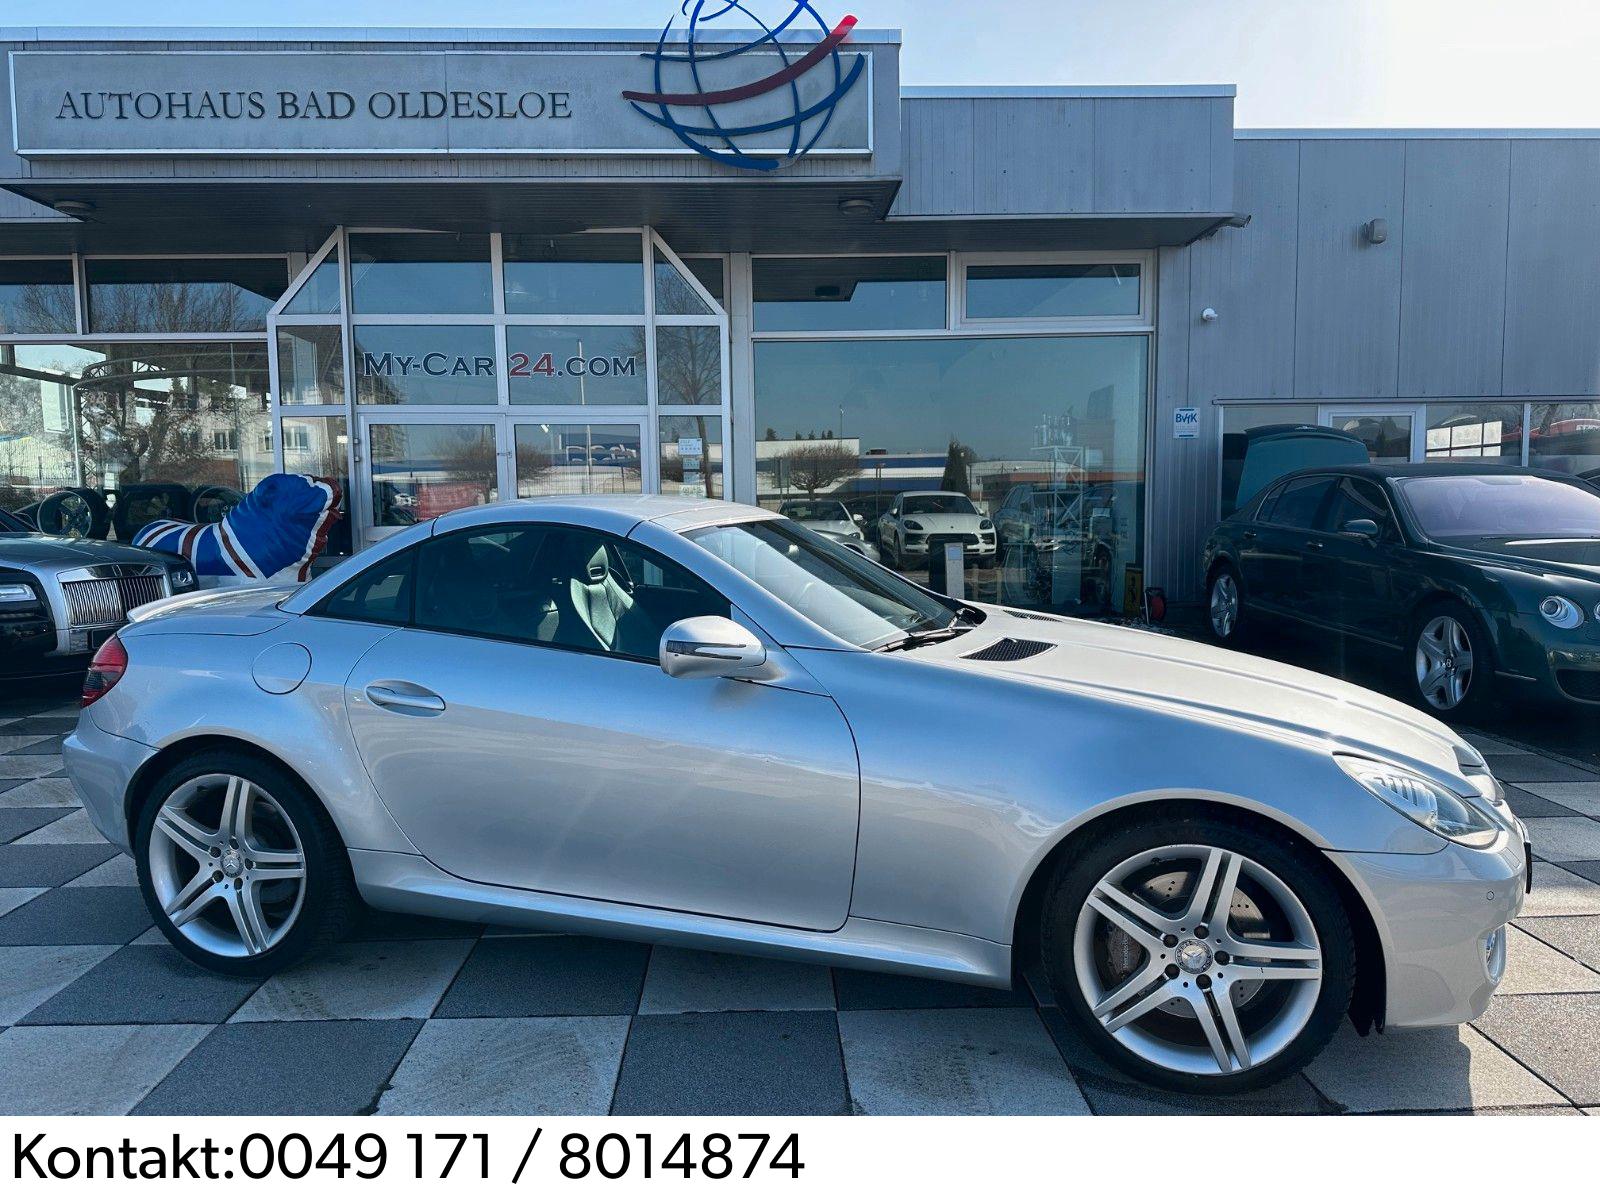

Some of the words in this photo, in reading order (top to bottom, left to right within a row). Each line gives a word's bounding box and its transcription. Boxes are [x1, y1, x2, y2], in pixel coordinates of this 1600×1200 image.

[55, 91, 266, 119] AUTOHAUS
[277, 91, 355, 119] BAD
[368, 91, 572, 119] OLDESLOE
